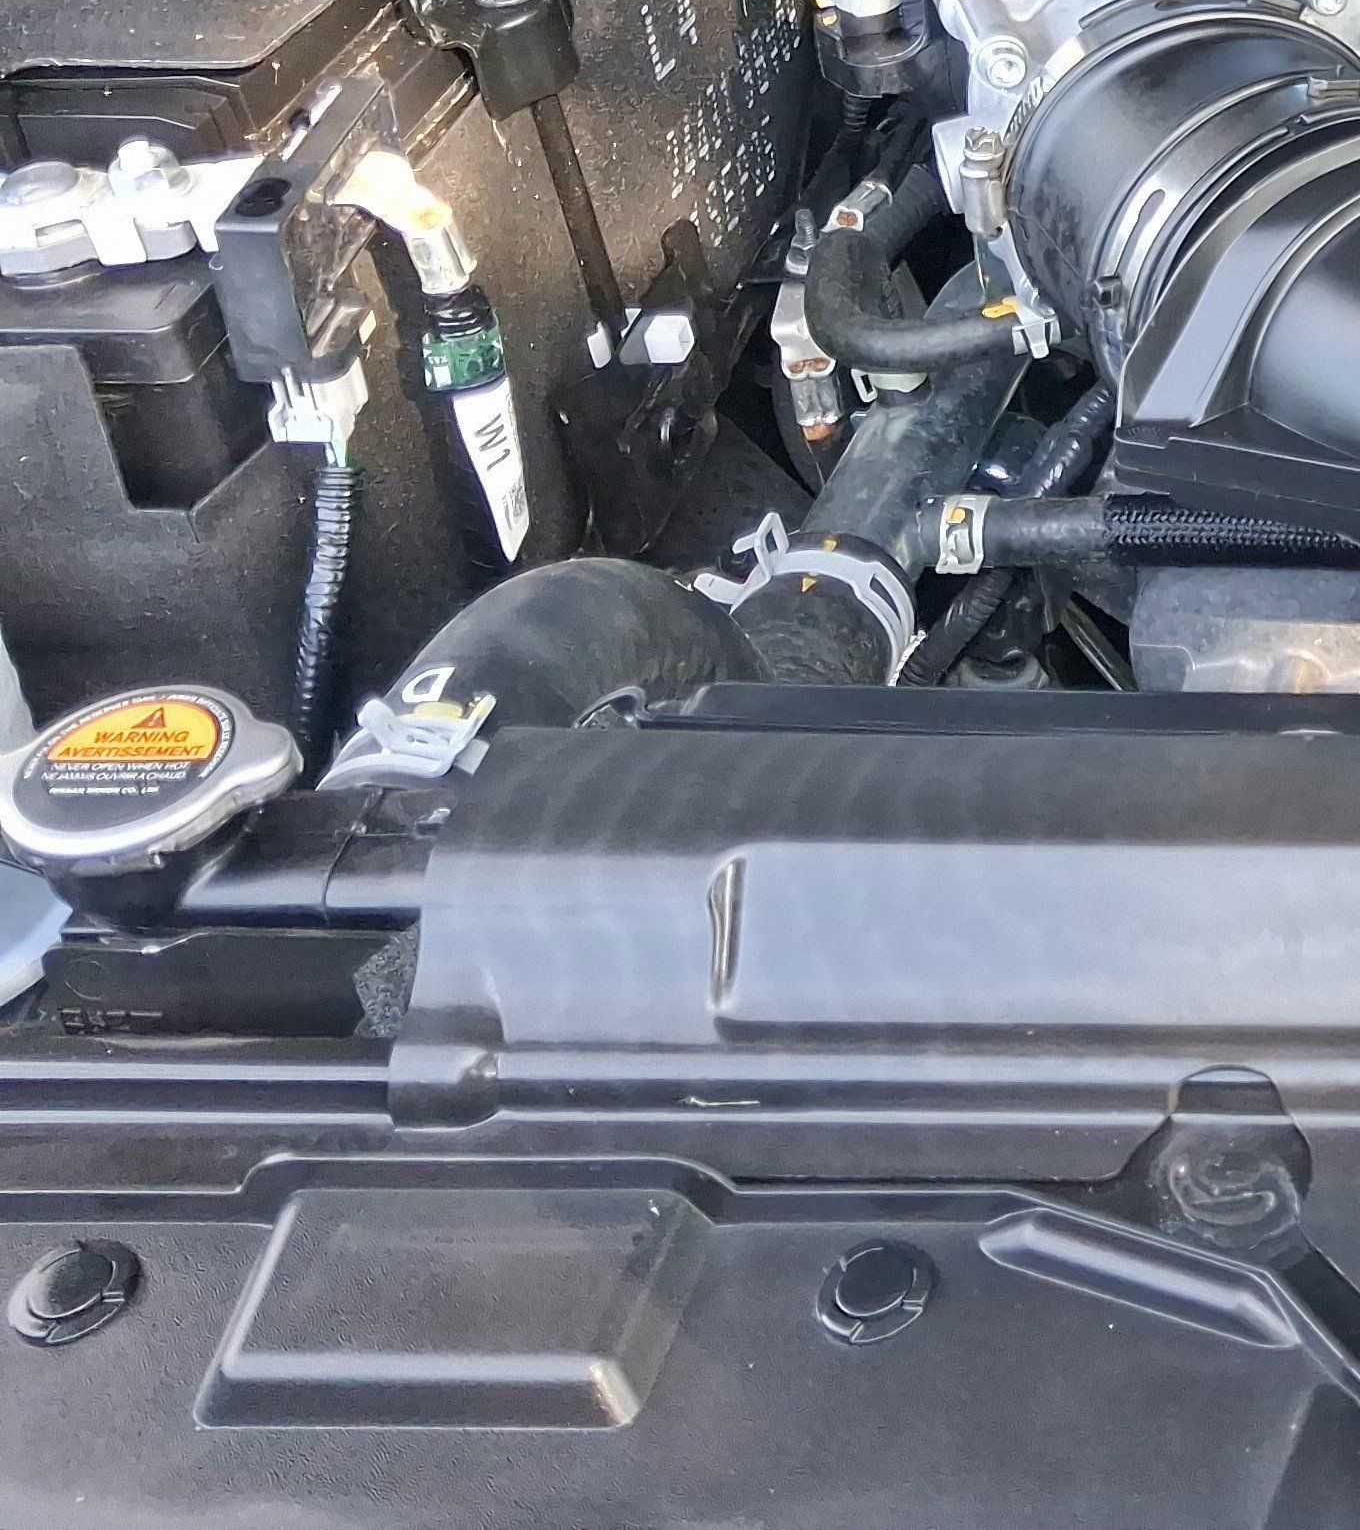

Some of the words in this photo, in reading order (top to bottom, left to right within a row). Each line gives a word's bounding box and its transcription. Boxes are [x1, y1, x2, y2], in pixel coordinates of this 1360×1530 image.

[93, 730, 190, 744] WARNING
[58, 744, 205, 757] AVERTISSEMENT
[52, 762, 90, 771] NEVER
[91, 762, 125, 771] OPEN
[127, 762, 162, 771] WHEN
[164, 761, 190, 770] HOT
